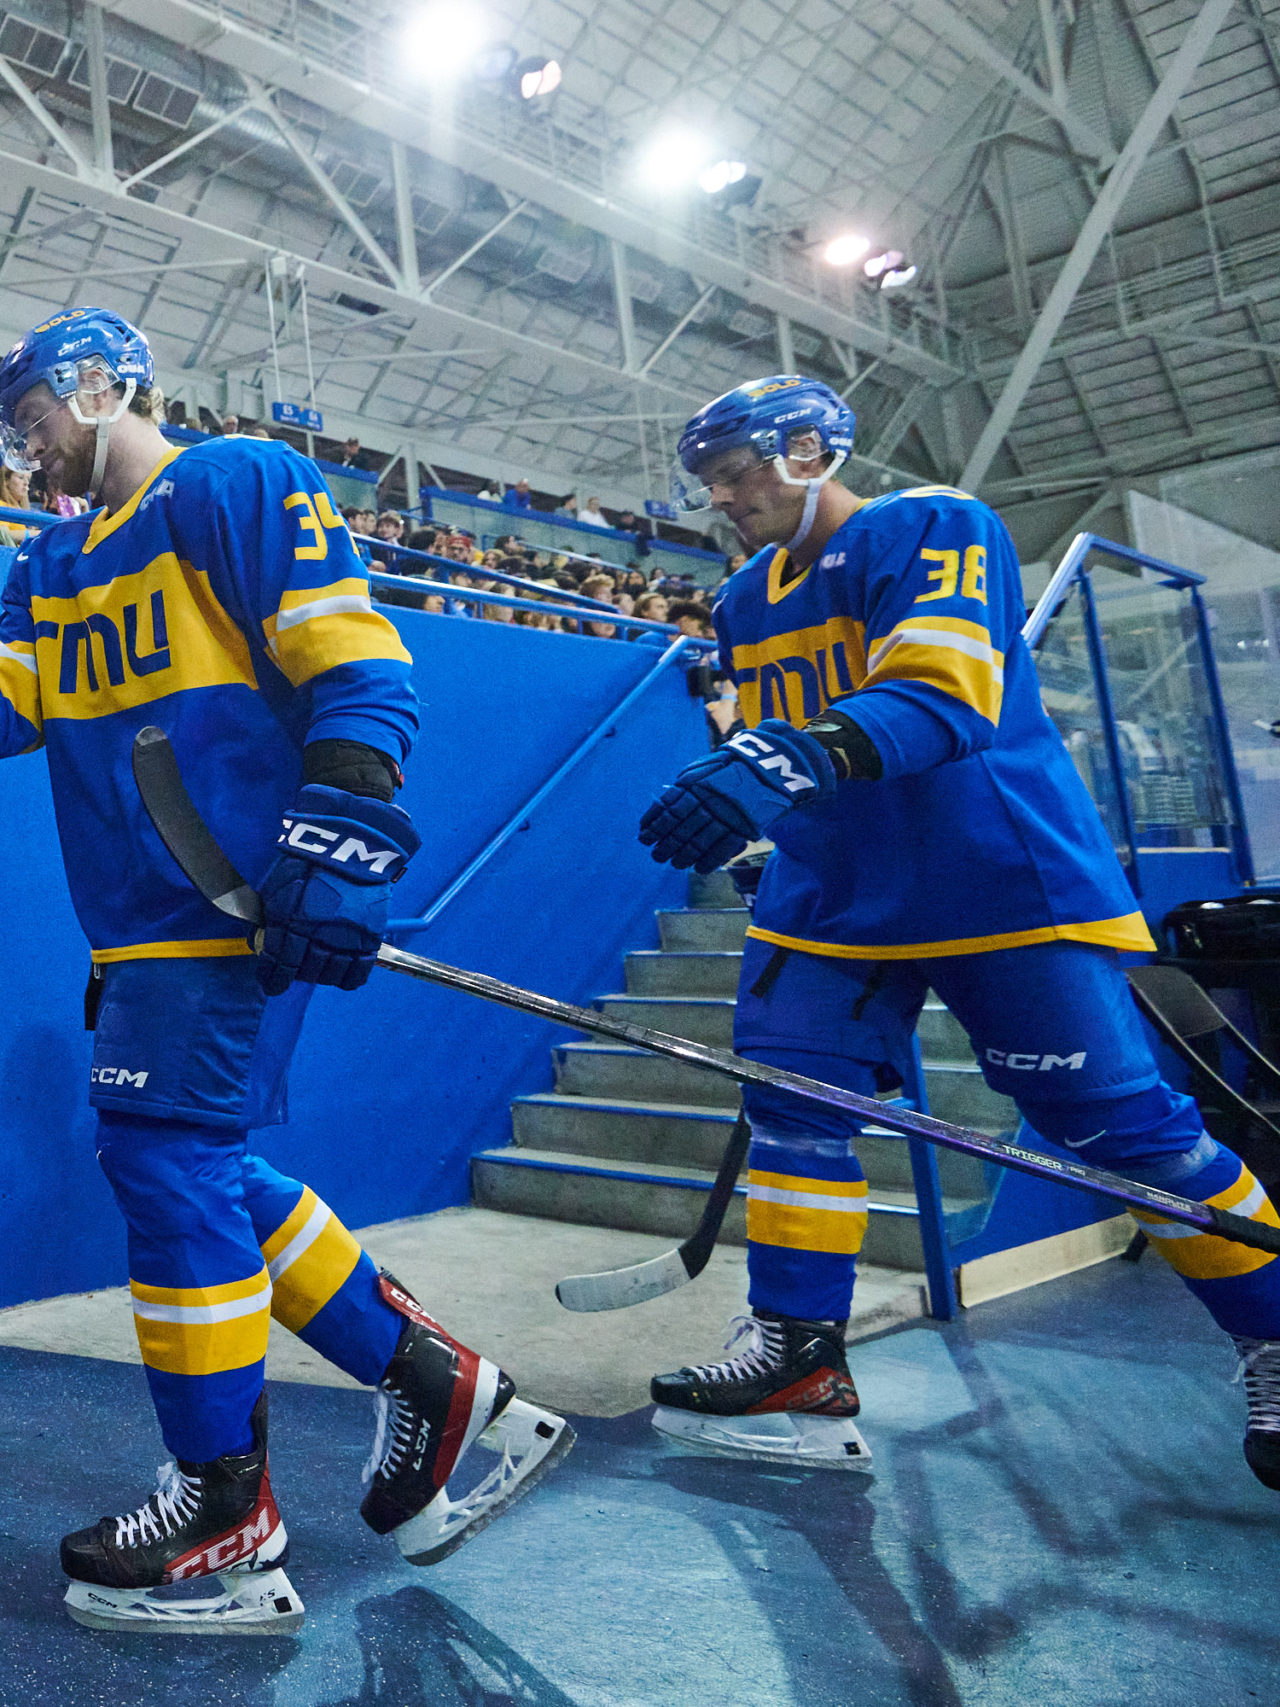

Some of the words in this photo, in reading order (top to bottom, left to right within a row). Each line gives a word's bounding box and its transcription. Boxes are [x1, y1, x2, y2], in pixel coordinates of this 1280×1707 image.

[773, 407, 812, 425] CCM
[914, 544, 988, 606] 38
[985, 1048, 1088, 1072] CCM
[90, 1067, 150, 1089] CCM
[1002, 1144, 1064, 1172] TRIGGER
[87, 1592, 118, 1609] CCM
